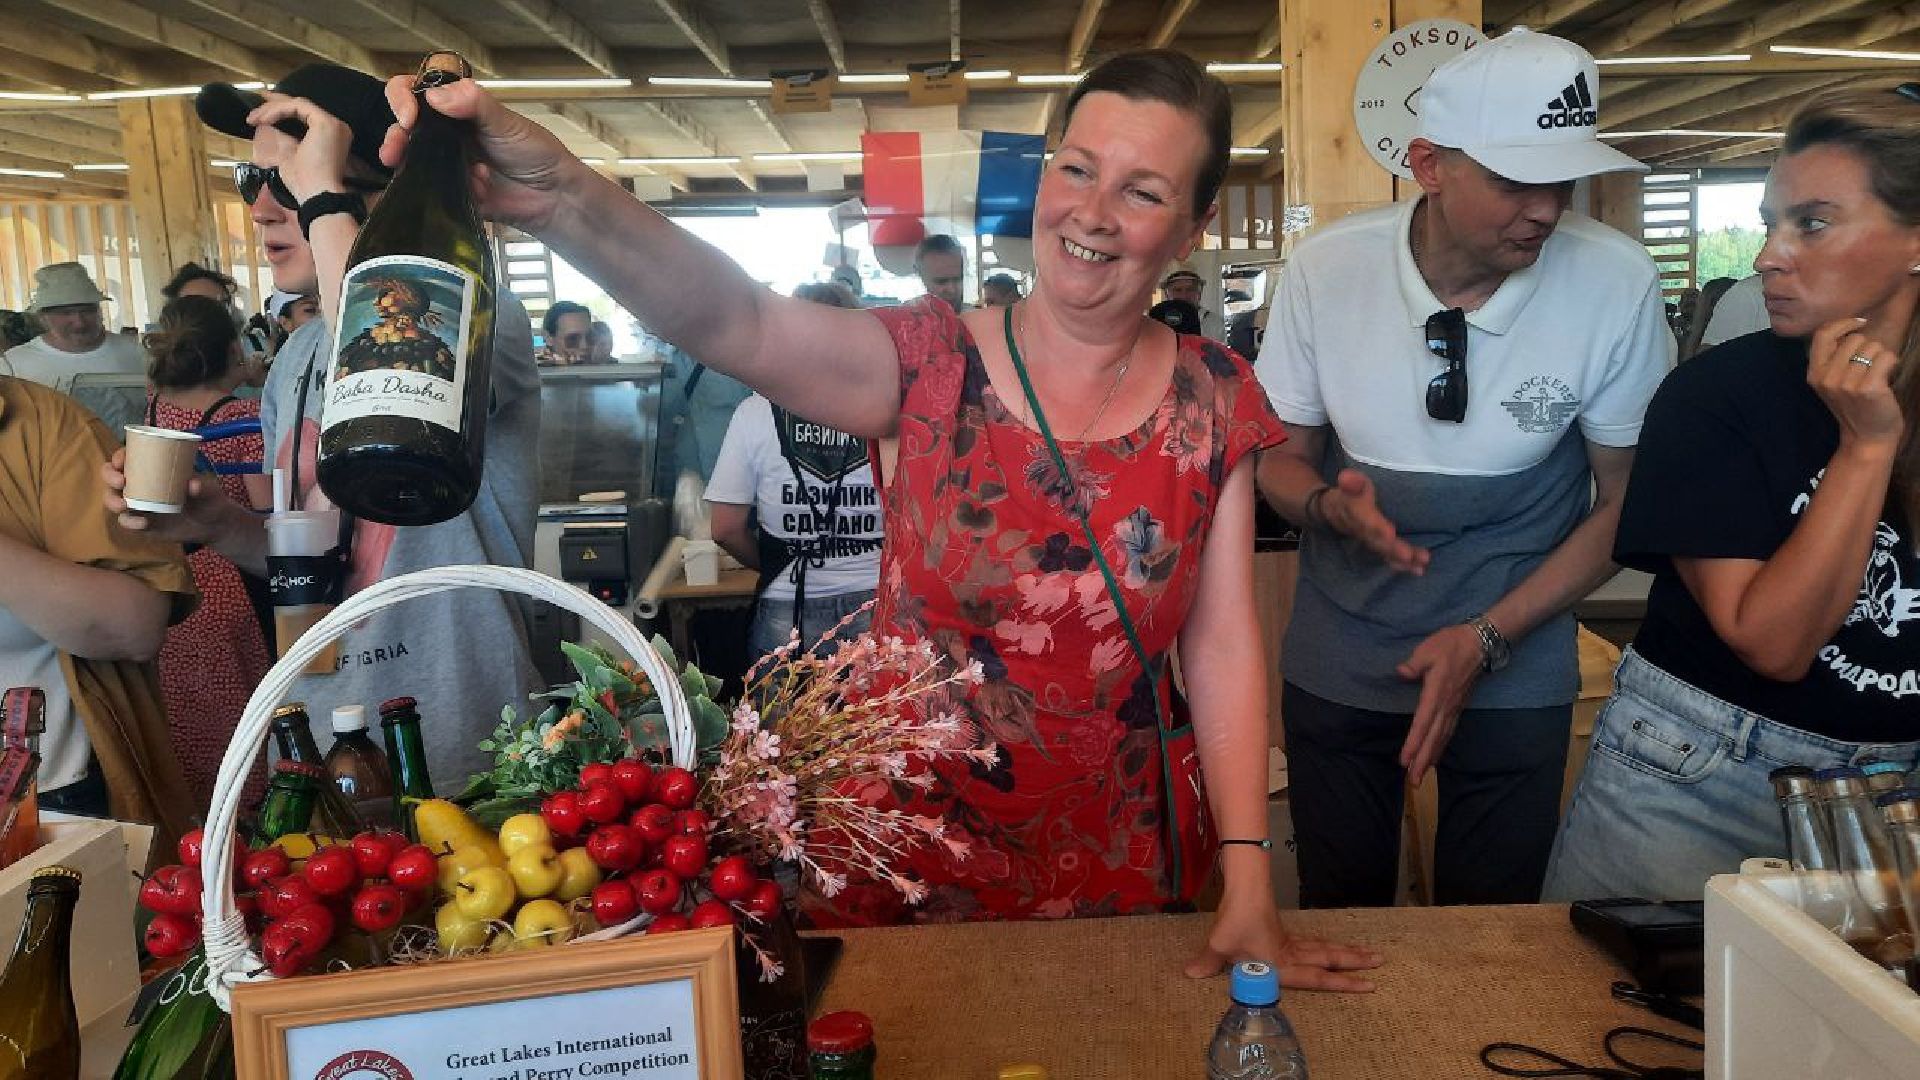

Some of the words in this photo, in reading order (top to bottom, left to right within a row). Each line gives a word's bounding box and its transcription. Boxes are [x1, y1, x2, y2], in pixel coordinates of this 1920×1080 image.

[333, 379, 373, 405] Baba
[382, 376, 446, 402] Dasha
[1513, 375, 1576, 401] DOCKERS
[1819, 645, 1920, 699] СИДРОД
[446, 1050, 496, 1069] Great
[501, 1045, 551, 1063] Lakes
[556, 1027, 673, 1055] International
[578, 1053, 690, 1077] Competition
